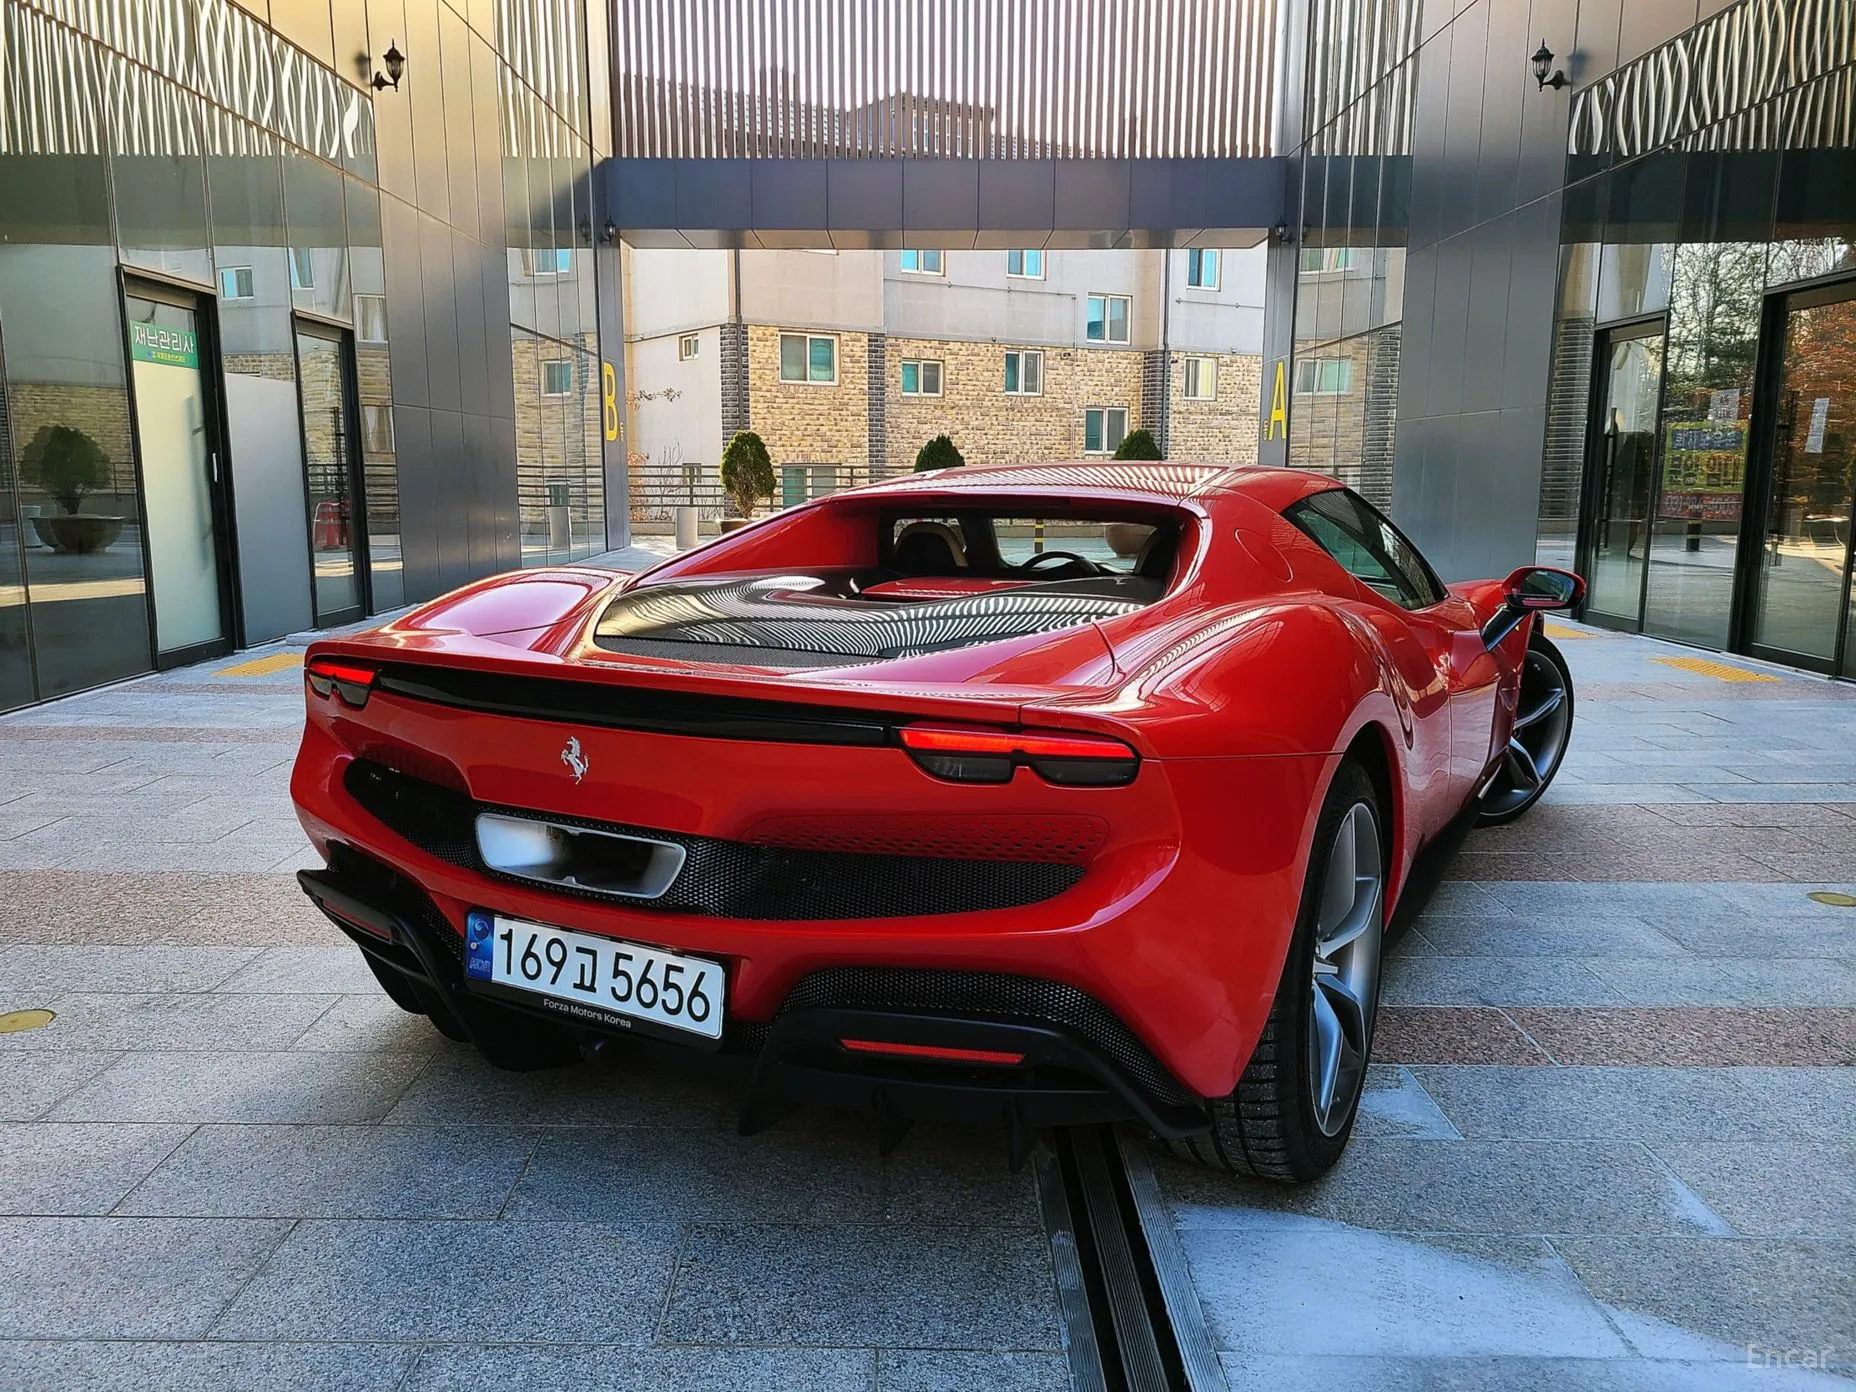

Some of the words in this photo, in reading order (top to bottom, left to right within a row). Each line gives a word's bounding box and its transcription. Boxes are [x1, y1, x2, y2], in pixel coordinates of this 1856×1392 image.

[134, 325, 194, 353] 재난관리사
[1268, 362, 1287, 440] A
[499, 928, 598, 993] 169고
[610, 951, 711, 1022] 5656
[543, 998, 570, 1013] Forza
[570, 1005, 603, 1022] Motors
[603, 1013, 632, 1029] Korea
